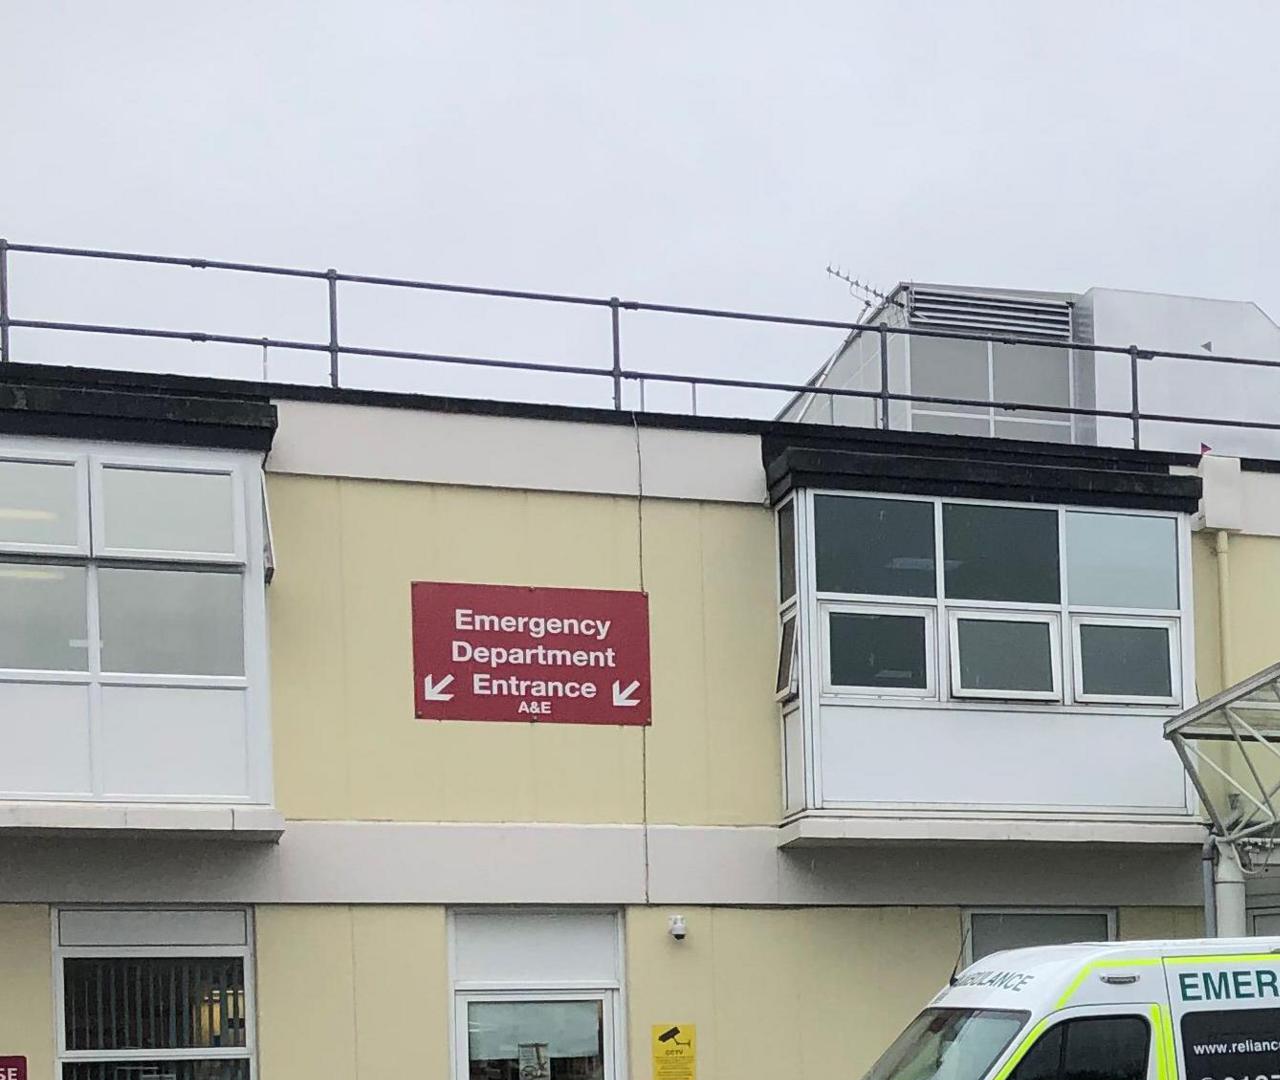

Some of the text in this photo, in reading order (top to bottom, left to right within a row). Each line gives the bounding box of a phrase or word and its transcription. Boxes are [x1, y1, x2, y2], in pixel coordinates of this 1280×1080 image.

[455, 608, 611, 639] Emergency
[451, 640, 616, 668] Department
[472, 673, 598, 698] Entrance
[517, 701, 552, 714] A&E
